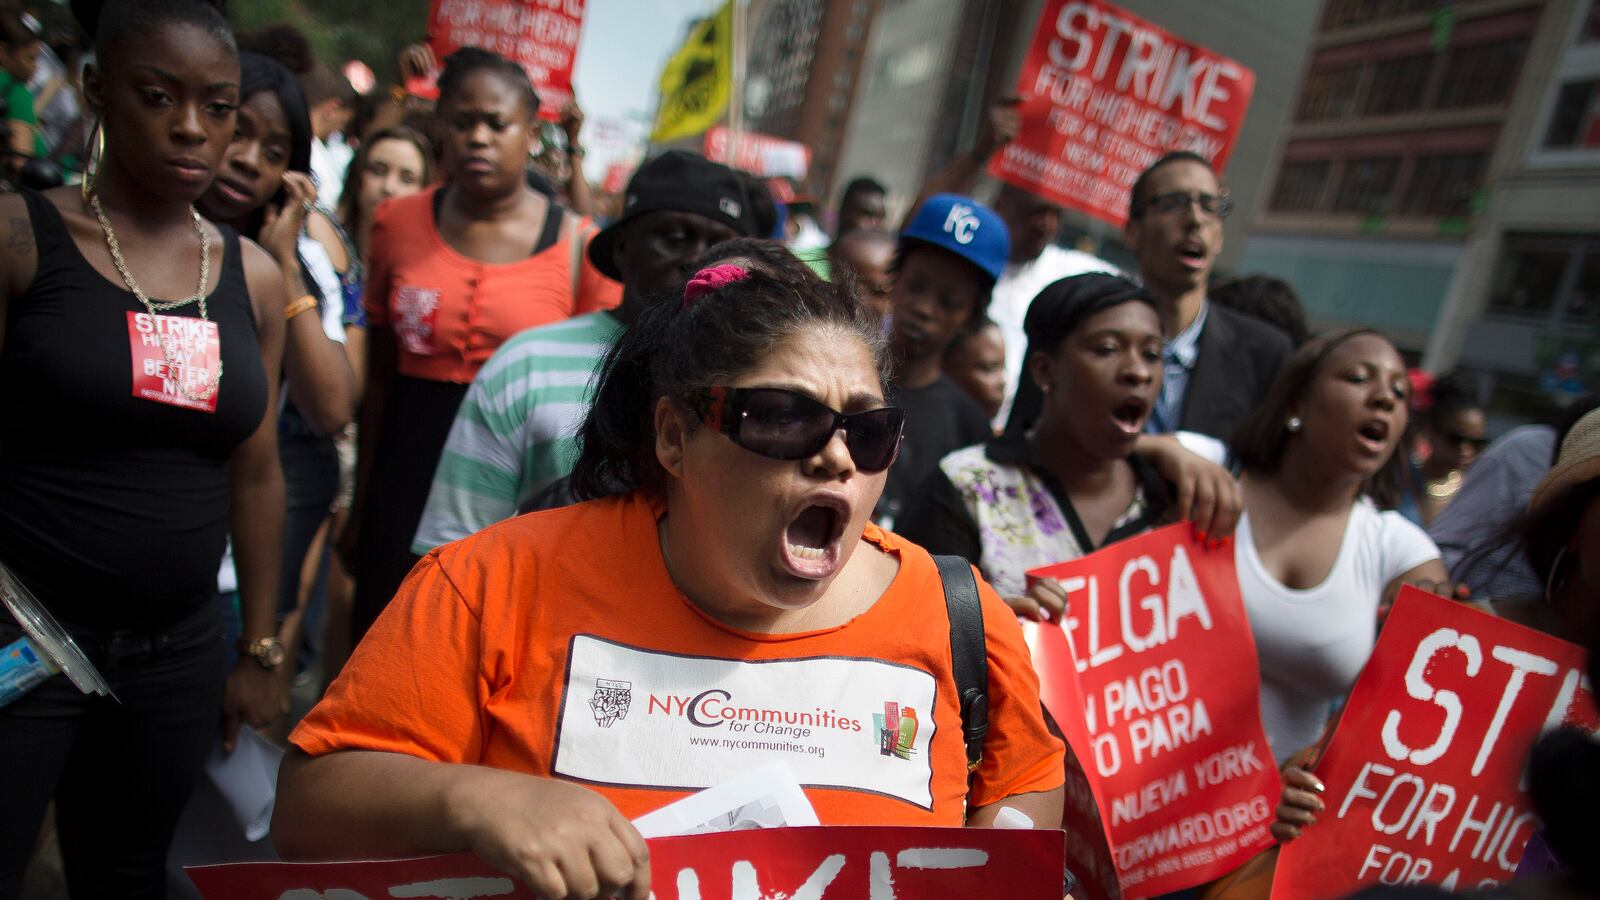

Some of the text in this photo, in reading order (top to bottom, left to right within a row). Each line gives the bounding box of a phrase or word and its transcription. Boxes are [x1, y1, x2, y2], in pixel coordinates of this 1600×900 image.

[1047, 2, 1242, 131] STRIKE
[1034, 64, 1092, 112] FOR
[1084, 87, 1182, 148] HIGHER
[943, 203, 981, 244] KC
[134, 312, 217, 342] STRIKE
[1104, 659, 1189, 727] PAGO
[689, 736, 825, 758] www.nycommunities.org
[729, 720, 811, 739] for Change
[1092, 697, 1213, 777] O PARA
[1112, 741, 1266, 827] NUEVA YORK
[1337, 761, 1456, 845] FOR
[1357, 844, 1433, 887] FOR
